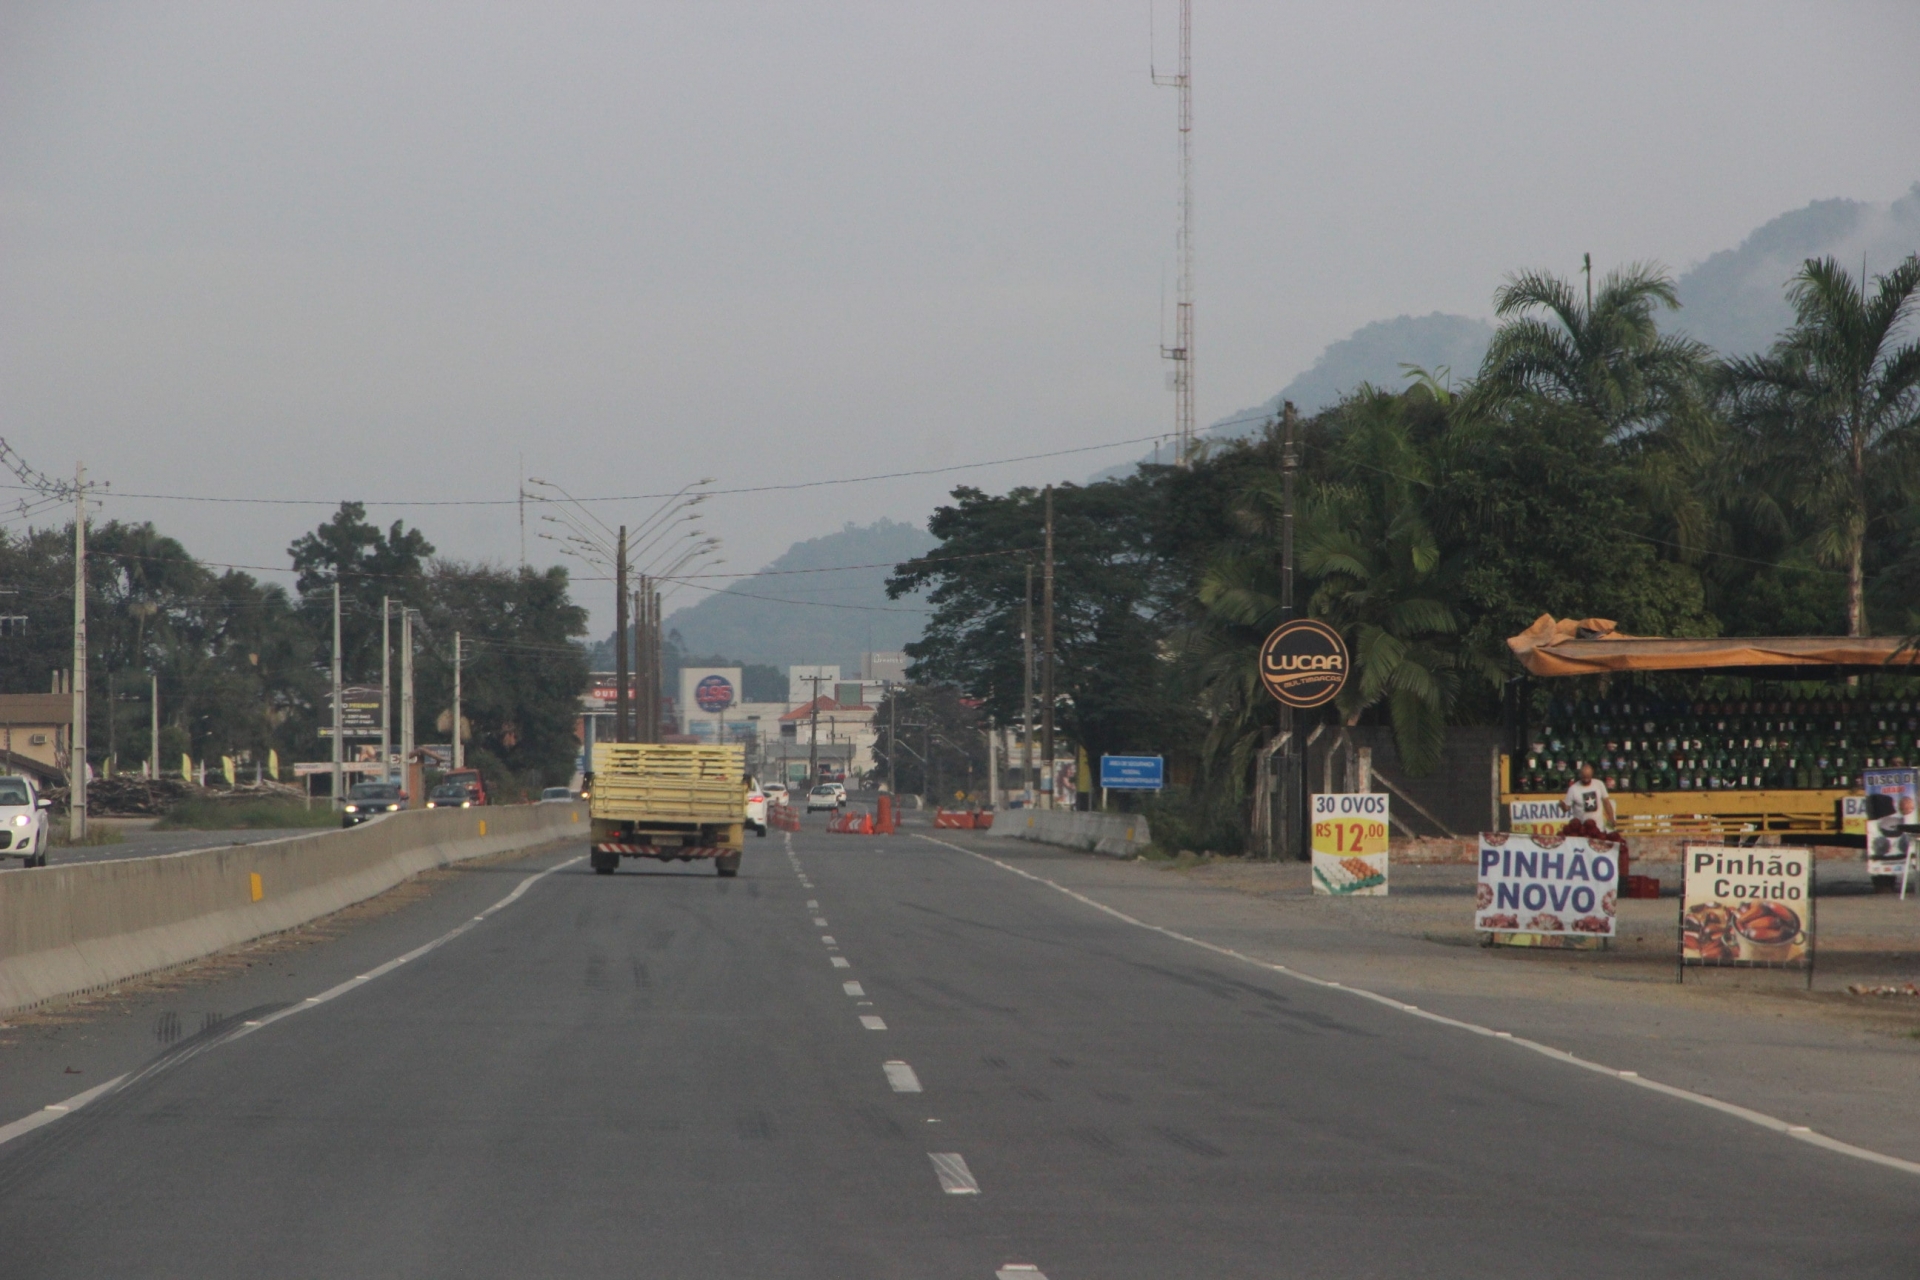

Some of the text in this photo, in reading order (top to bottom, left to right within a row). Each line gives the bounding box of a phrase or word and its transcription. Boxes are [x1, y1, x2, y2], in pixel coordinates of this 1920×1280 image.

[1267, 655, 1343, 670] LUCAR
[1283, 675, 1342, 689] MULTIMARCAS
[594, 690, 635, 698] OUTLT
[1867, 774, 1900, 786] DISCO
[1316, 797, 1385, 813] 30 OVOS
[1315, 823, 1332, 838] R$
[1480, 848, 1615, 882] PINHÃO
[1694, 853, 1802, 877] Pinhão
[1714, 879, 1801, 900] Cozido
[1497, 882, 1596, 914] NOVO
